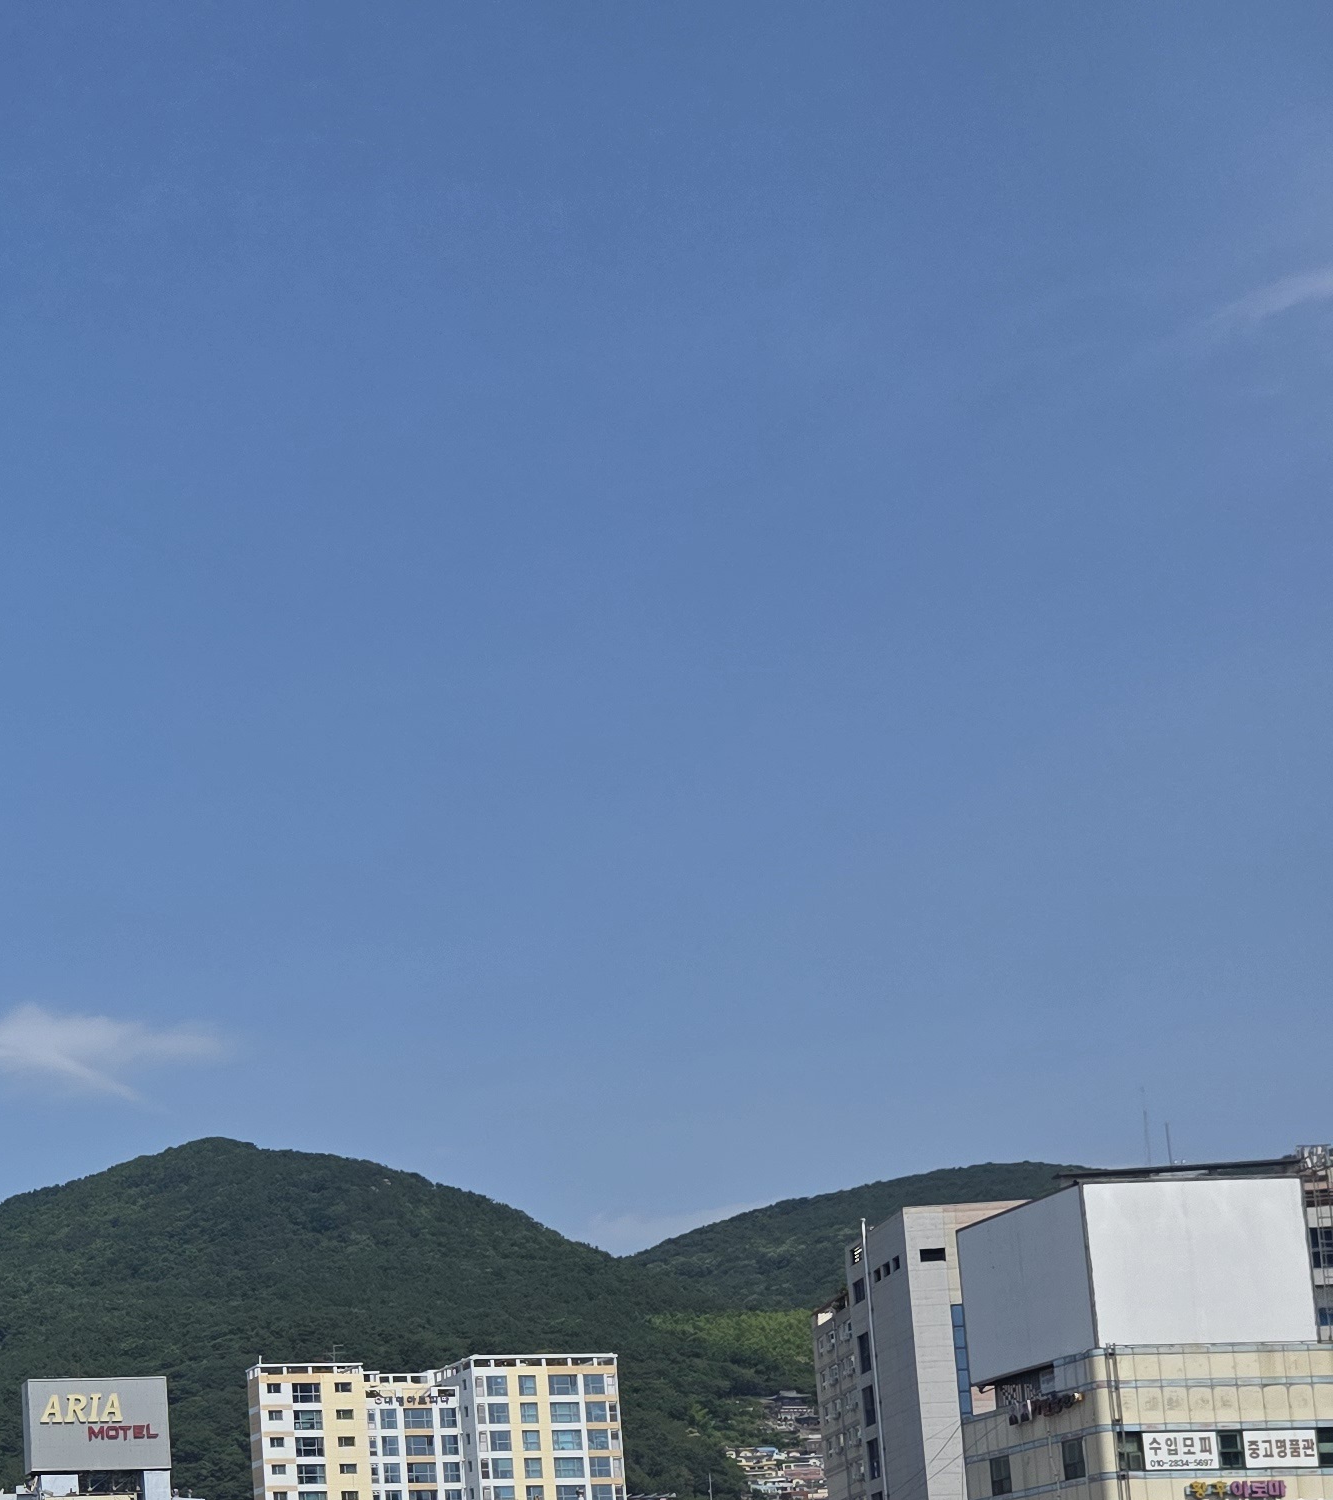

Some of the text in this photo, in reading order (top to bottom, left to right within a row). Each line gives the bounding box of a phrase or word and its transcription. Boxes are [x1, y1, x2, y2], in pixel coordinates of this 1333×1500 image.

[39, 1392, 123, 1424] ARIA
[87, 1424, 159, 1442] MOTEL
[1148, 1436, 1316, 1460] 수입모피 중고명품관
